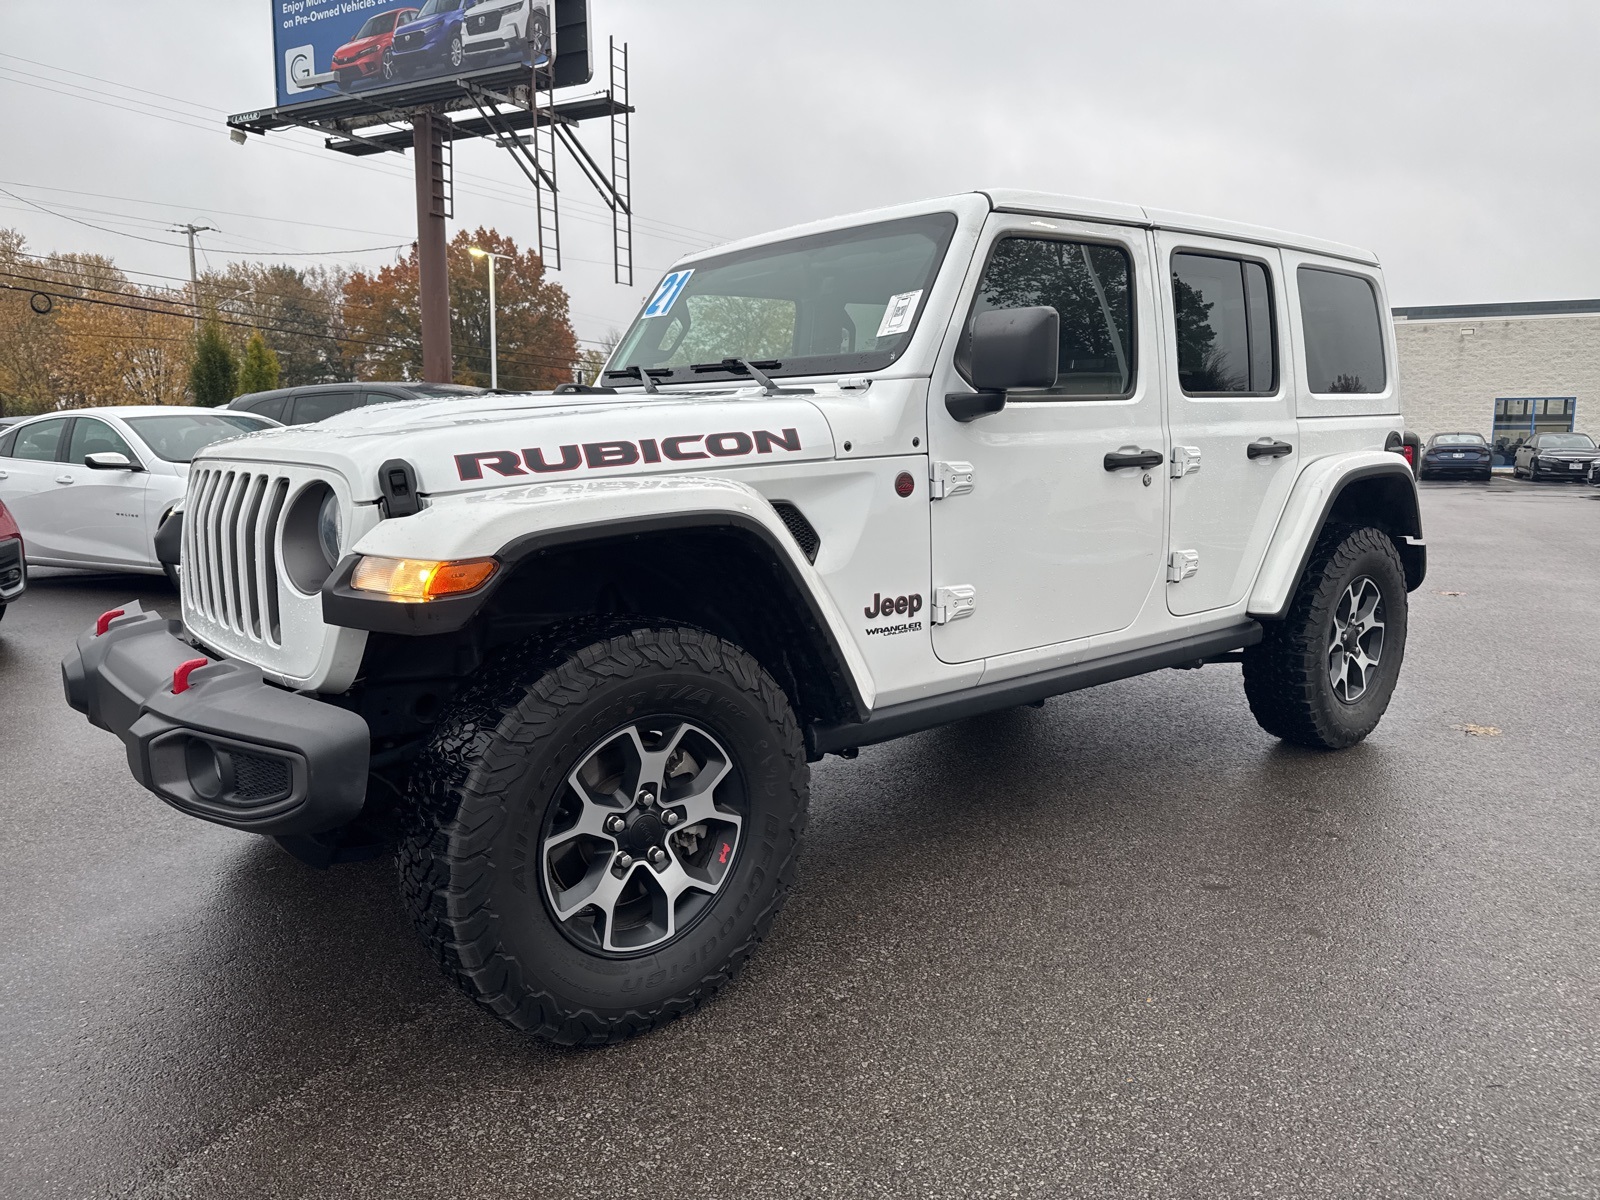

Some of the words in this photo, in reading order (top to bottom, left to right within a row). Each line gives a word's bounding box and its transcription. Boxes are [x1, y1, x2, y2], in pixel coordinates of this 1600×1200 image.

[282, 1, 304, 14] Enjoy
[283, 19, 294, 29] on
[295, 4, 340, 26] Pre-Owned
[341, 0, 376, 14] Vehicles
[234, 112, 259, 124] LAMAR
[645, 270, 691, 315] 21
[453, 427, 803, 482] RUBICON
[864, 592, 923, 619] Jeep
[865, 621, 922, 636] WRANGLER
